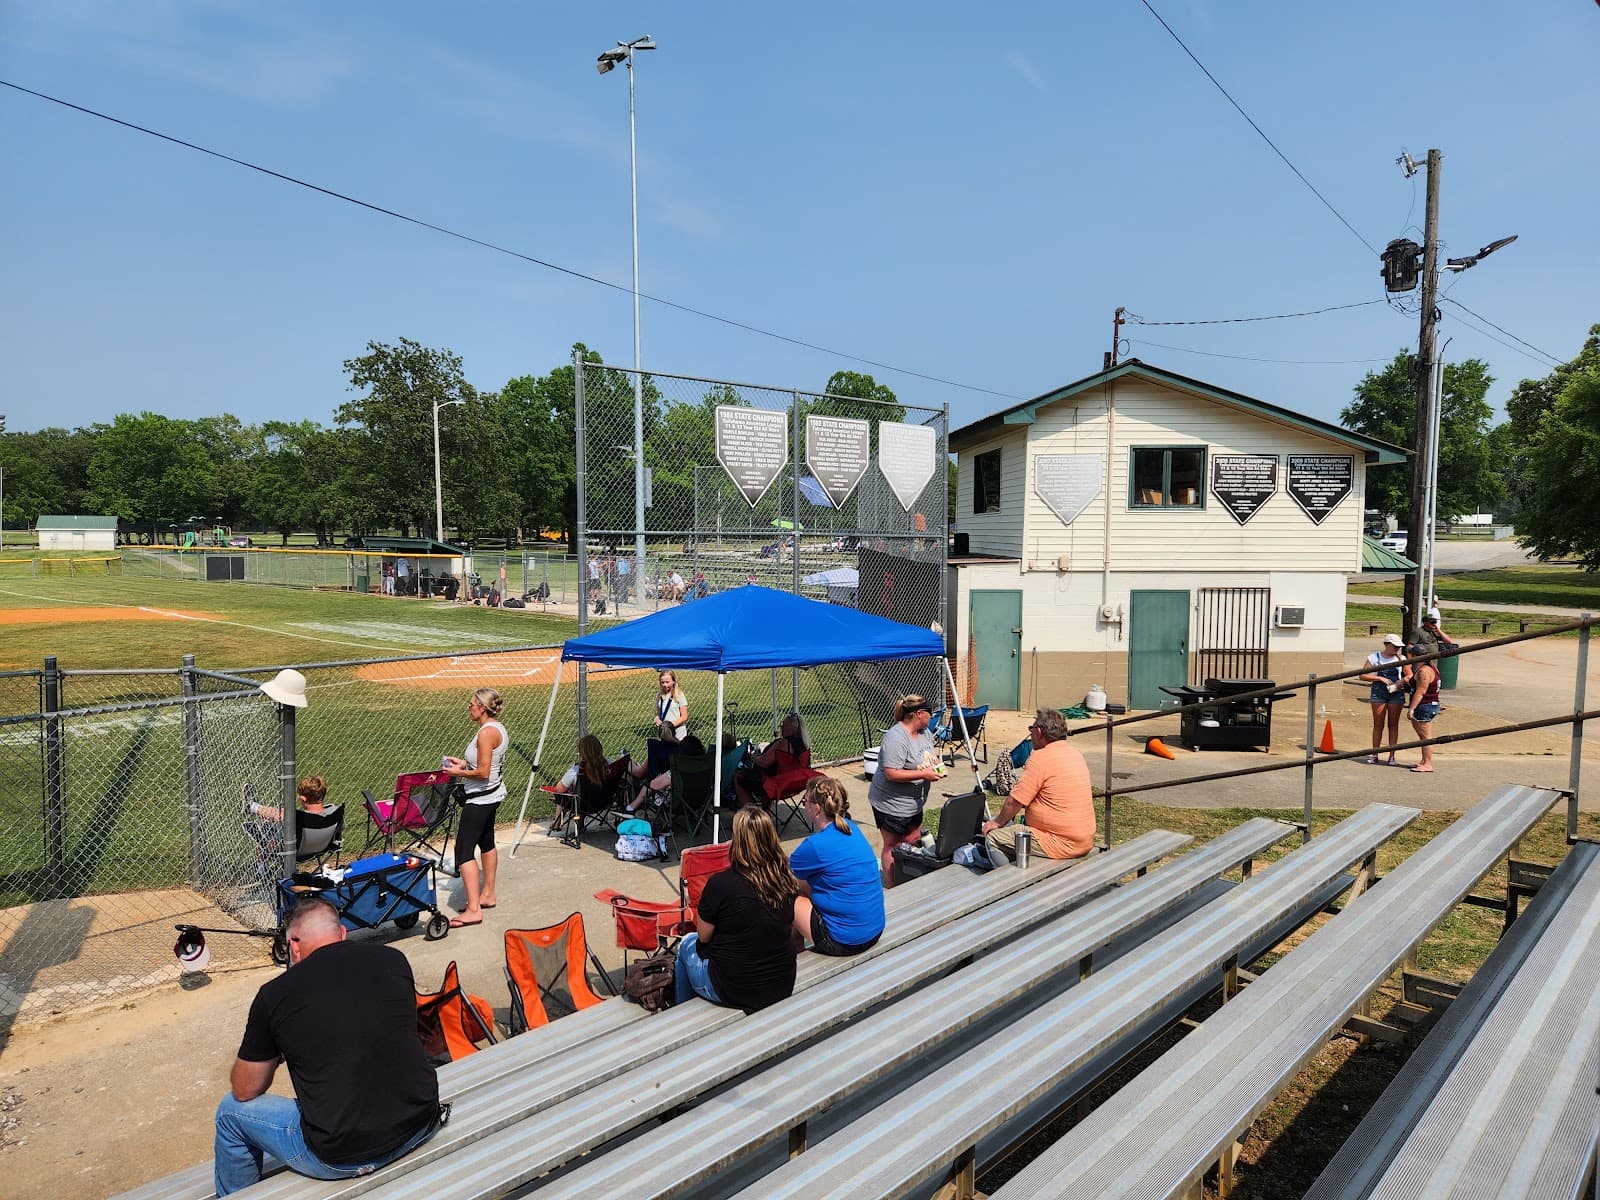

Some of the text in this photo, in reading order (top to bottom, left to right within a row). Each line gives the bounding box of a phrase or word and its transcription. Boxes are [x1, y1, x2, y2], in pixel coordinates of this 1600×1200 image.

[734, 413, 751, 421] STATE
[752, 414, 784, 423] CHAMPIONS
[838, 422, 866, 430] CHAMPIONS
